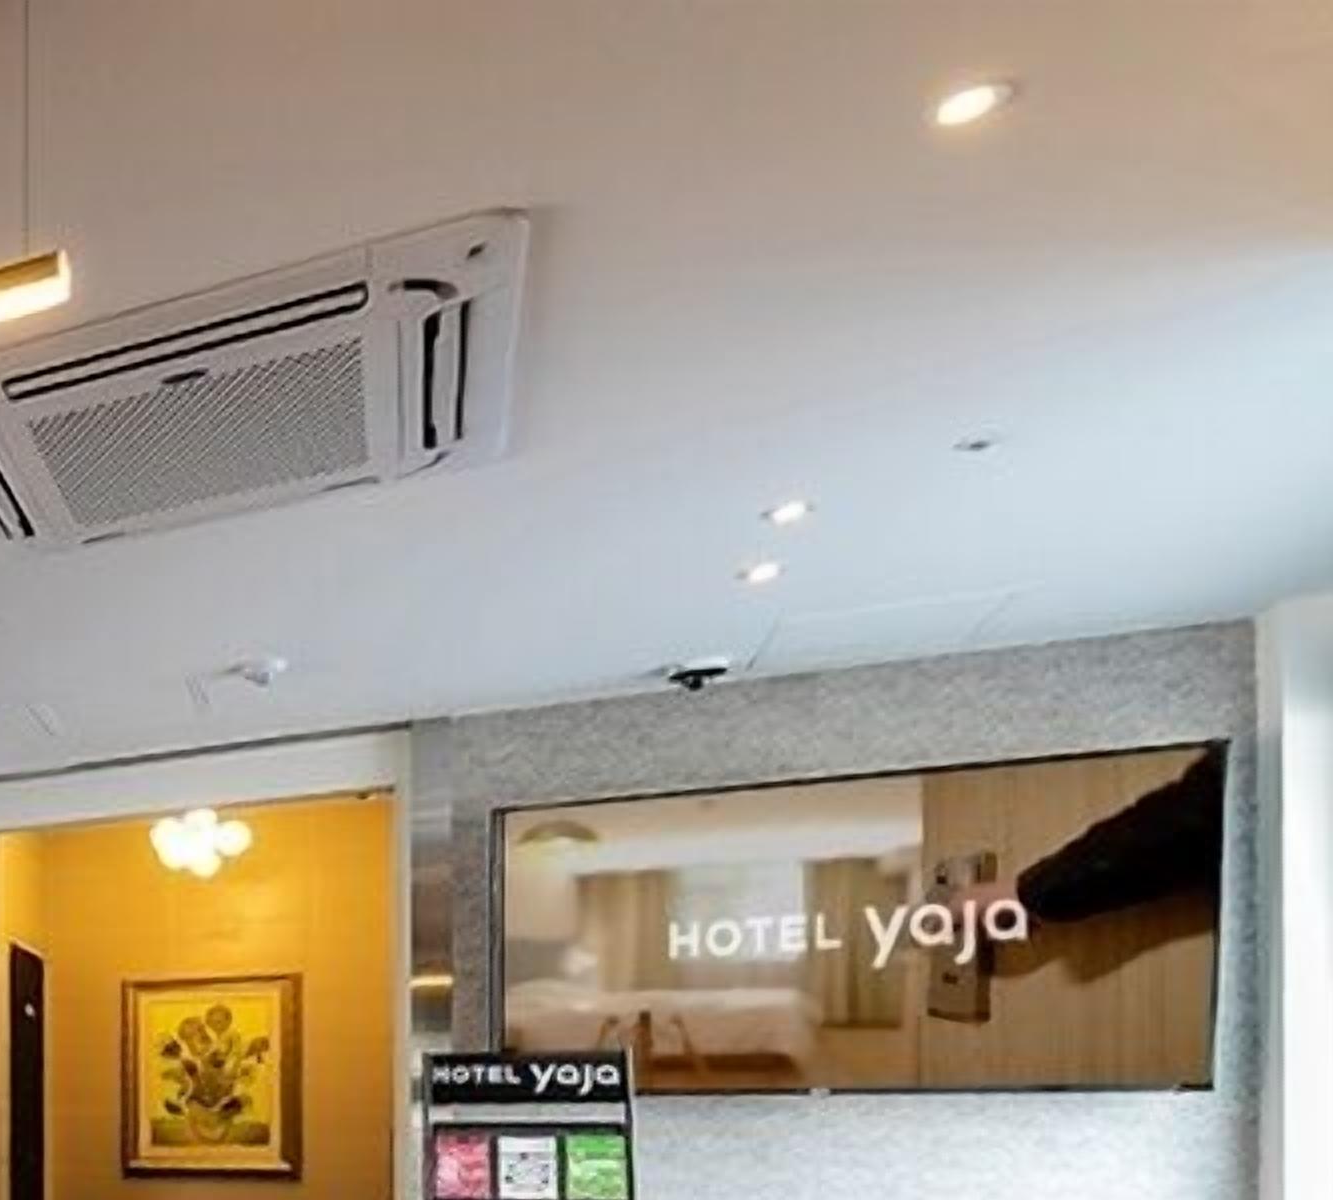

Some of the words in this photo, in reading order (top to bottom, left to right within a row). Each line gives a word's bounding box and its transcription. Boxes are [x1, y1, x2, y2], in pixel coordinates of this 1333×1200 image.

[667, 912, 843, 961] HOTEL
[863, 898, 1029, 970] yaja
[432, 1063, 522, 1086] HOTEL
[529, 1062, 621, 1097] yaja
